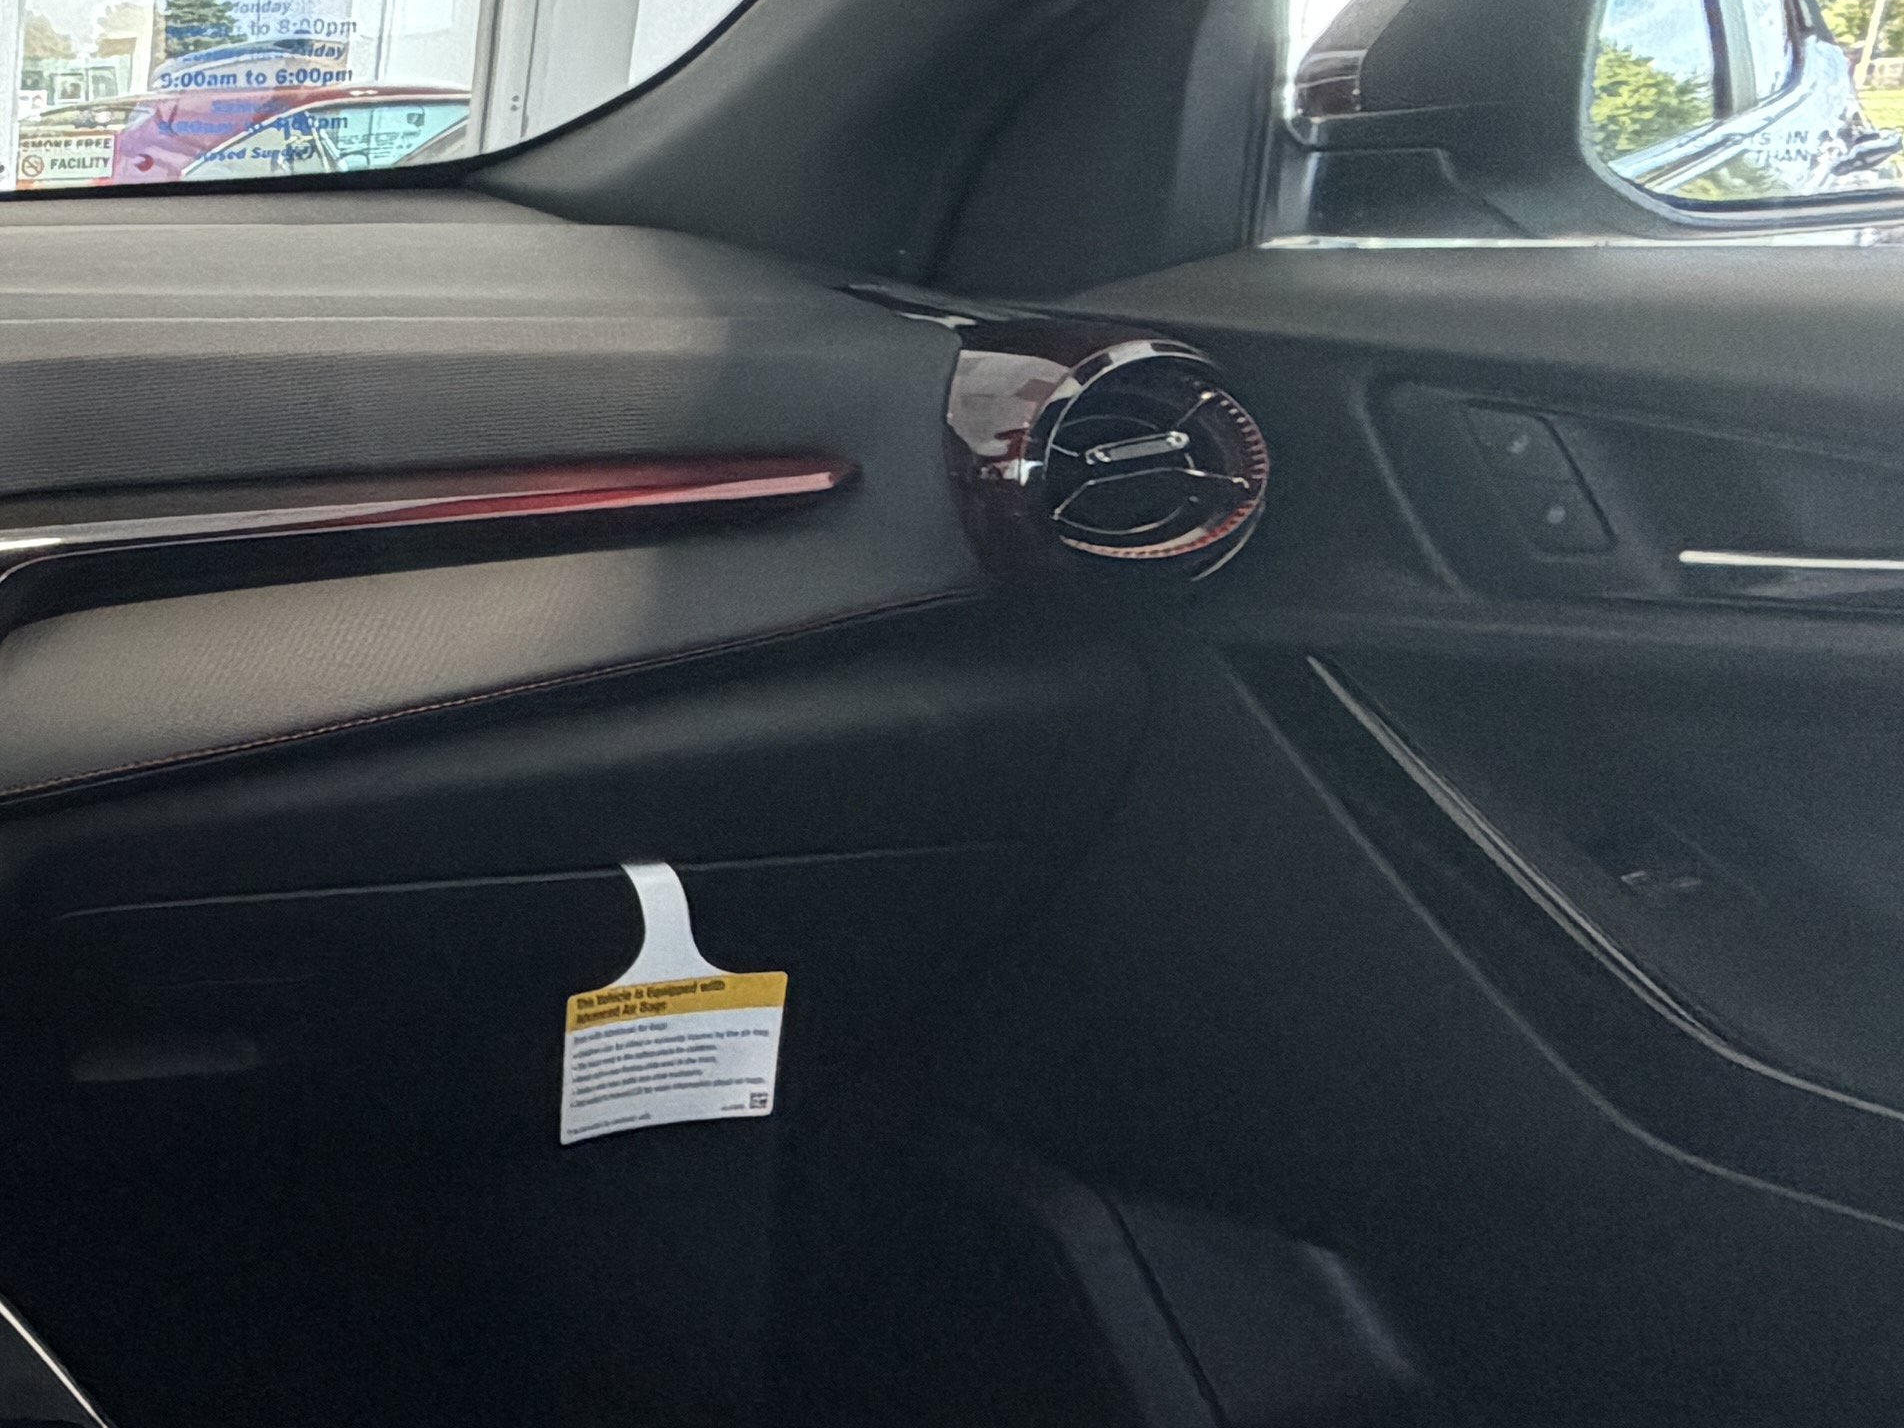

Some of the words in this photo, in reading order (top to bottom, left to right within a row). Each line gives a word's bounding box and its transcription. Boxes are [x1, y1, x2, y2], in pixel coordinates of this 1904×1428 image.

[249, 20, 271, 36] to
[159, 71, 237, 89] 9:00am
[245, 70, 267, 85] to
[275, 68, 353, 88] 6:00pm
[50, 157, 111, 169] FACILITY
